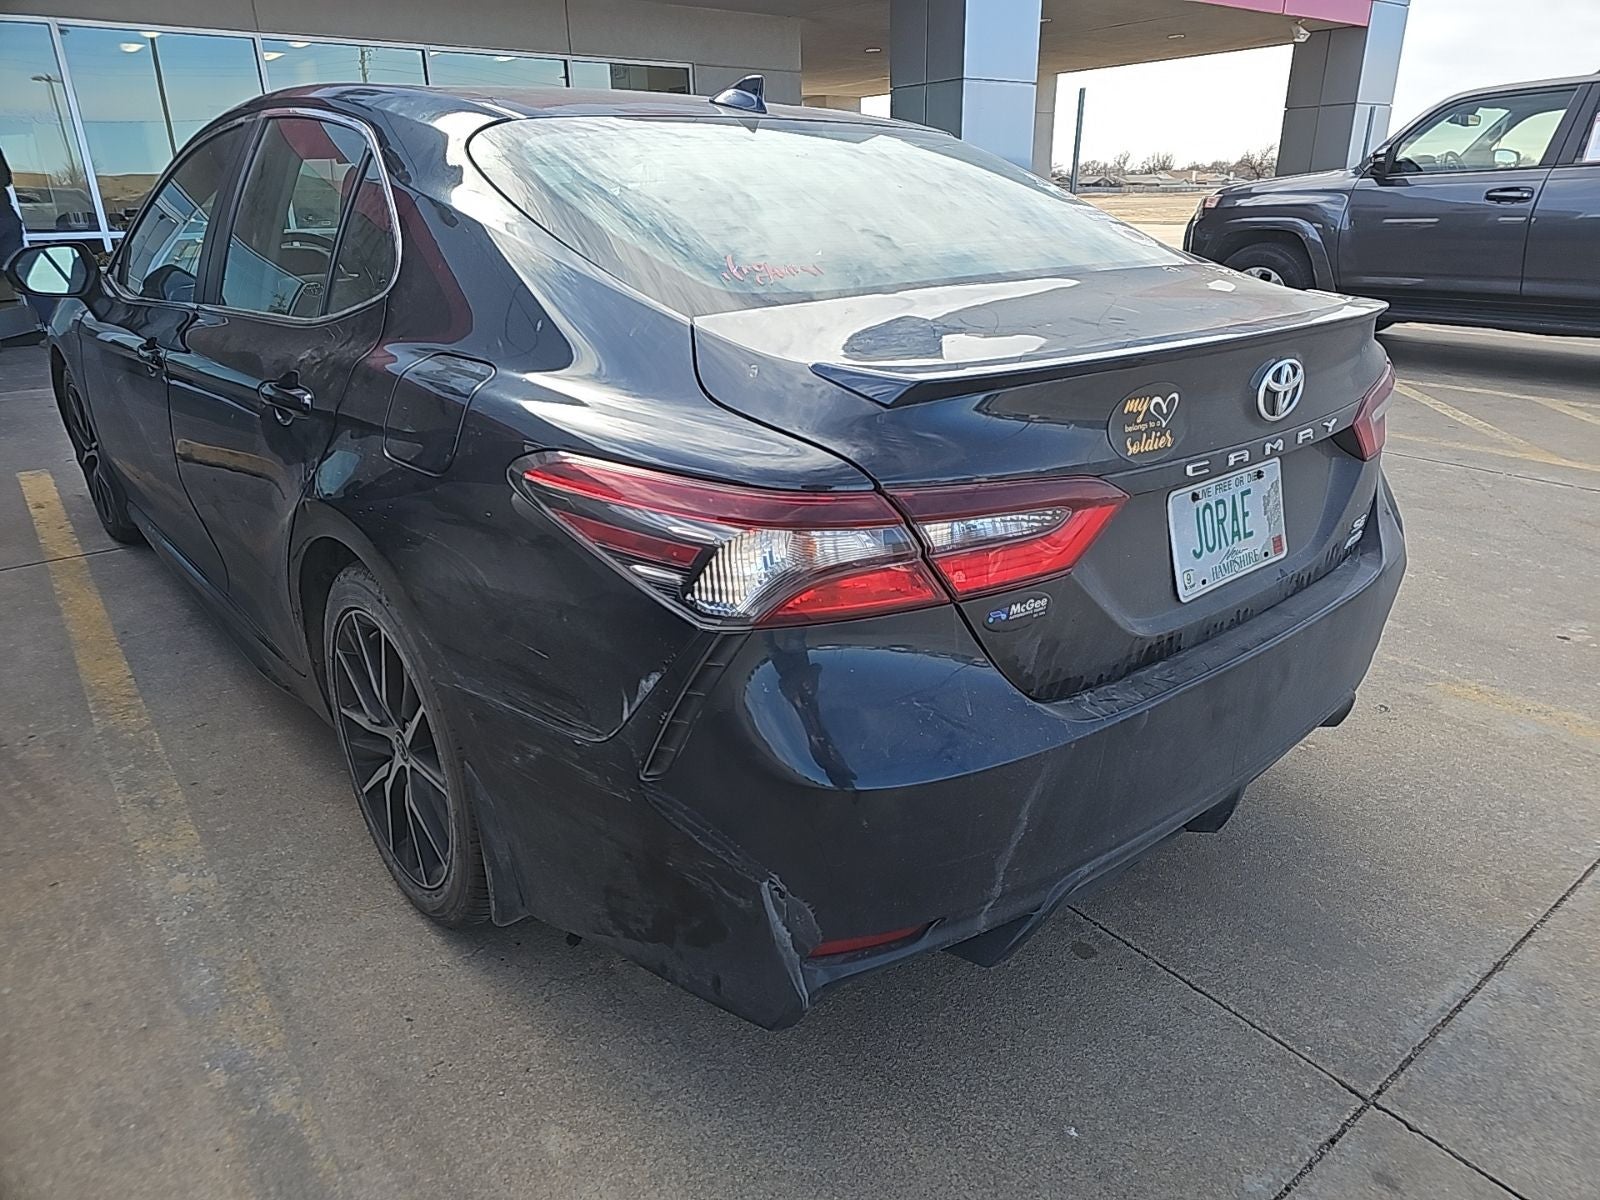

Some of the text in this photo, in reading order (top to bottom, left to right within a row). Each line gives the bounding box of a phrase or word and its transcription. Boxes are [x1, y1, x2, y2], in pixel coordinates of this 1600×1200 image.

[1124, 396, 1150, 423] my
[1125, 421, 1148, 433] belongs
[1149, 420, 1156, 428] to
[1186, 418, 1337, 477] CAMRY
[1215, 479, 1232, 496] FREE
[1234, 475, 1245, 488] OR
[1192, 488, 1254, 560] JORAE
[1211, 548, 1260, 581] HAMPSHIRE
[1009, 598, 1047, 615] McGee
